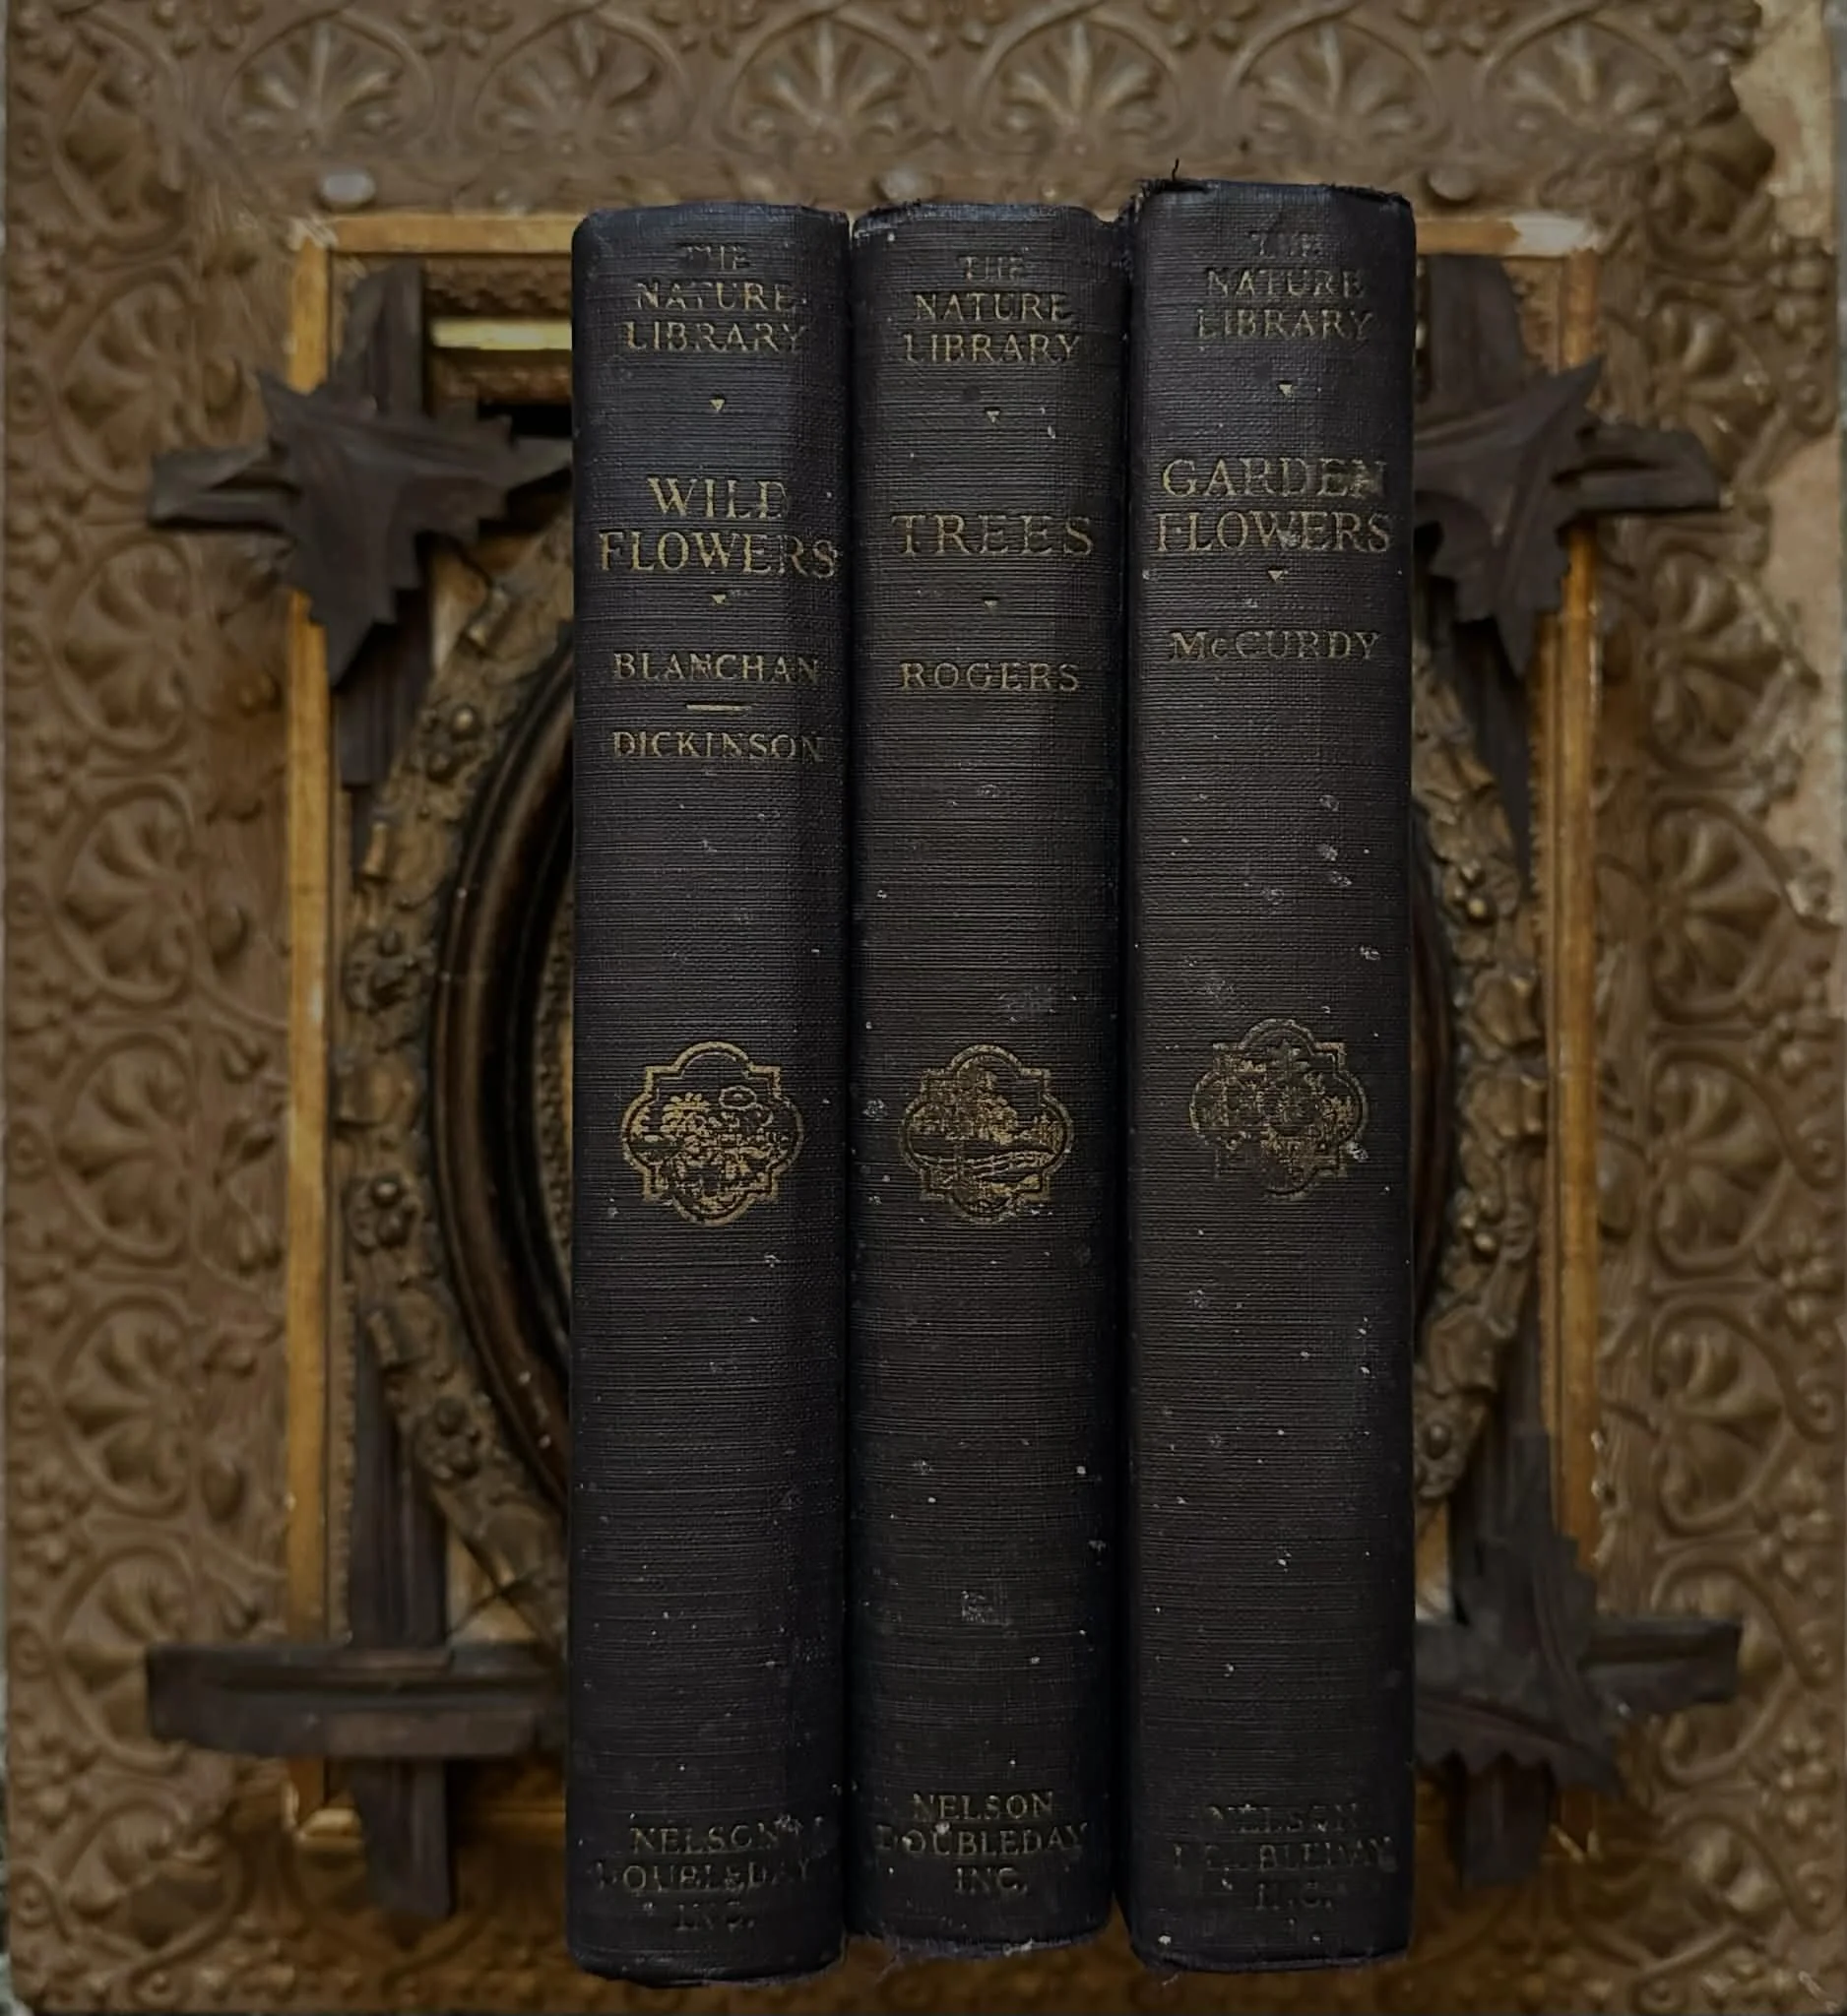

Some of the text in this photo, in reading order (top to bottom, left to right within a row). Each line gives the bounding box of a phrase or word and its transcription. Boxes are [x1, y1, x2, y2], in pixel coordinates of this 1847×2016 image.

[635, 282, 803, 311] NATURE
[1207, 269, 1367, 297] NATURE
[915, 292, 1073, 323] NATURE
[622, 321, 807, 352] LIBRARY
[1196, 309, 1374, 341] LIBRARY
[903, 333, 1080, 364] LIBRARY
[1162, 458, 1388, 498] GARDEN
[646, 476, 789, 521] WILD
[890, 513, 1094, 556] TREES
[1156, 510, 1391, 553] FLOWERS
[599, 532, 840, 579] FLOWERS
[1170, 630, 1381, 662] McCURDY
[612, 653, 820, 684] BLANCHAN
[900, 662, 1080, 692] ROGERS
[611, 731, 825, 764] DICKINSON
[913, 1791, 1054, 1821] NELSON
[874, 1822, 1088, 1858] DOUBLEDAY
